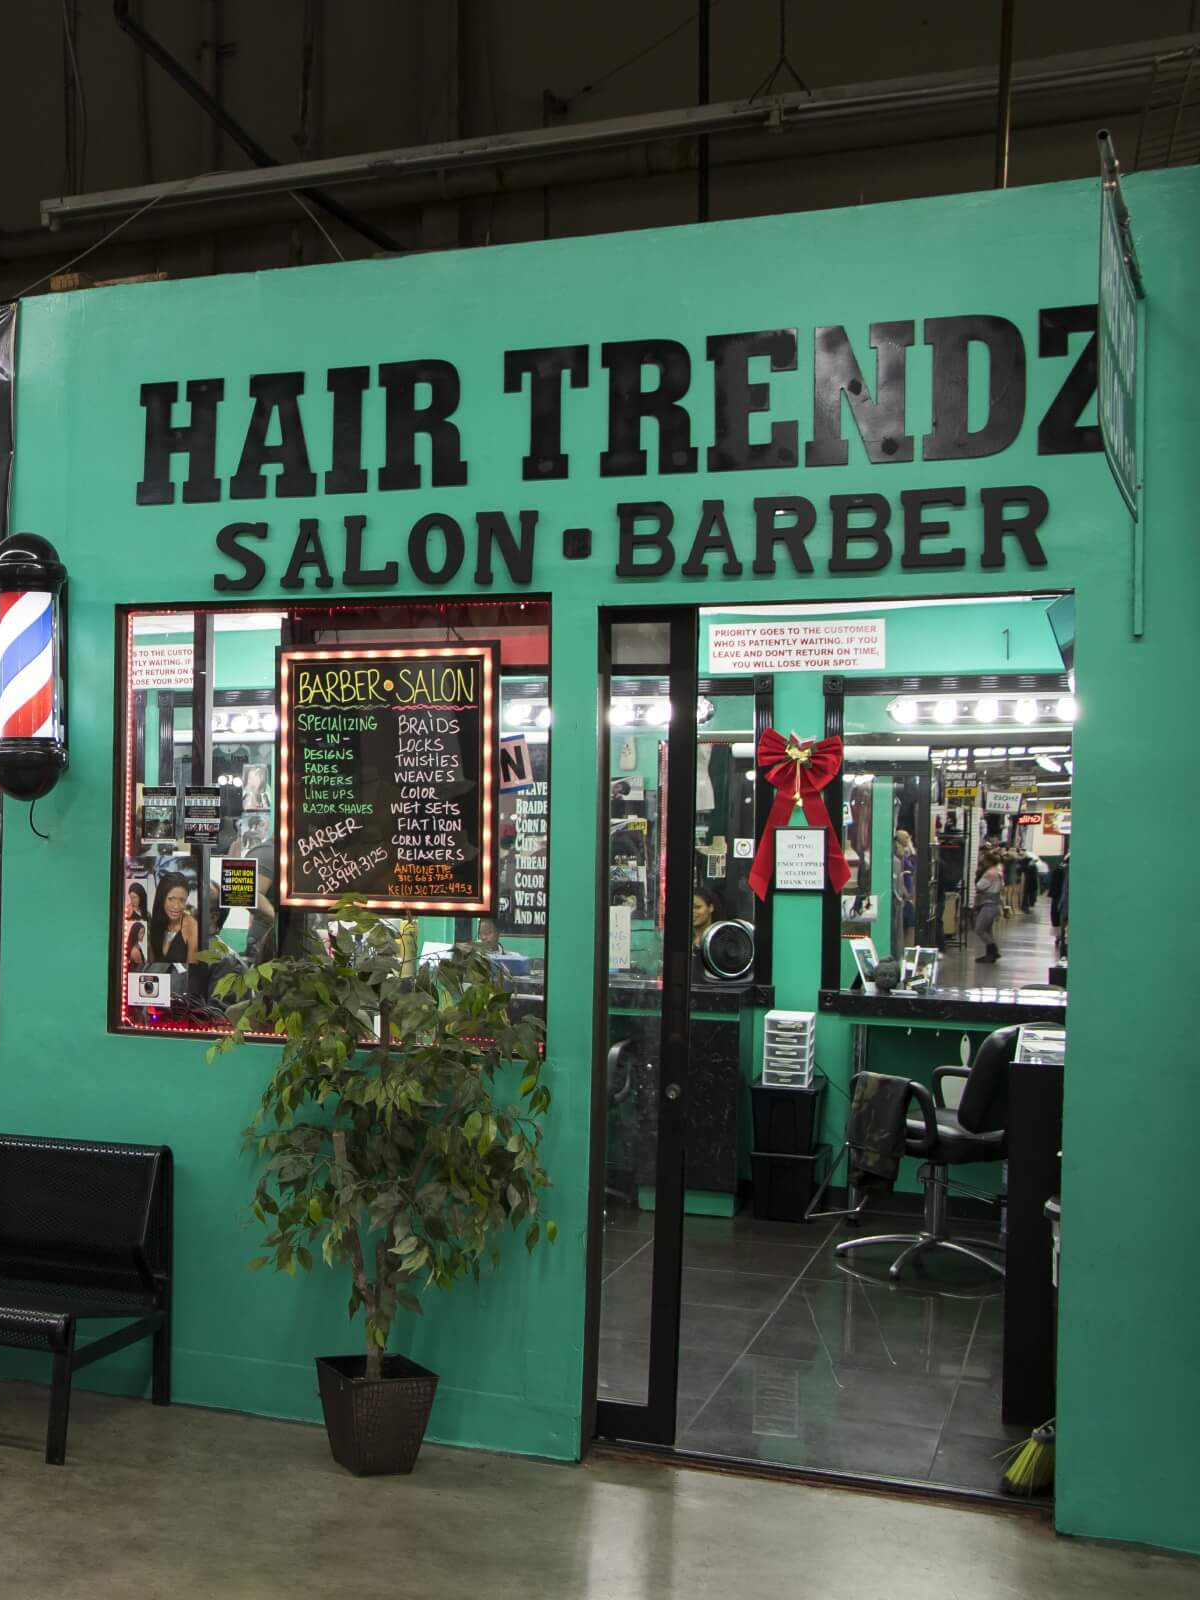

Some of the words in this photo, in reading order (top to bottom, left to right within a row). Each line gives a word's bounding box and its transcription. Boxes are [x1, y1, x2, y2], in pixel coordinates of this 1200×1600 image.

[136, 358, 468, 506] HAIR
[503, 303, 1106, 481] TRENDZ
[213, 509, 540, 592] SALON
[615, 485, 1050, 578] BARBER
[715, 628, 757, 637] PRIORITY
[760, 628, 784, 636] GOES
[788, 627, 800, 635] TO
[803, 627, 821, 635] THE
[823, 625, 877, 634] CUSTOMER
[714, 640, 735, 648] WHO
[738, 639, 746, 647] IS
[749, 638, 797, 647] PATIENTLY
[800, 637, 843, 646] WAITING.
[858, 636, 878, 644] YOU
[712, 650, 741, 658] LEAVE
[743, 649, 762, 658] AND
[765, 649, 792, 657] DON'T
[795, 648, 834, 656] RETURN
[836, 648, 850, 656] ON
[732, 660, 750, 669] YOU
[752, 660, 775, 668] WILL
[777, 659, 801, 667] LOSE
[804, 659, 830, 667] YOUR
[298, 669, 386, 703] BARBER
[395, 667, 474, 704] SALON
[398, 737, 444, 753] LOCKS
[304, 748, 354, 760] DESIGNS
[304, 762, 338, 774] FADES
[501, 745, 527, 783] N
[302, 775, 353, 786] TAPPERS
[394, 770, 455, 783] WEAVES
[304, 787, 329, 800] LINE
[332, 789, 354, 800] UPS
[302, 802, 337, 814] RAZOR
[338, 803, 374, 814] SHAVES
[432, 815, 461, 831] IRON
[515, 818, 539, 833] CORN
[297, 817, 364, 857] BARBER
[391, 834, 421, 846] CORN
[302, 846, 340, 874] CALL
[318, 852, 353, 880] RICK
[317, 876, 340, 895] 213
[514, 872, 544, 889] COLOR
[514, 892, 535, 907] WET
[514, 910, 532, 925] AND
